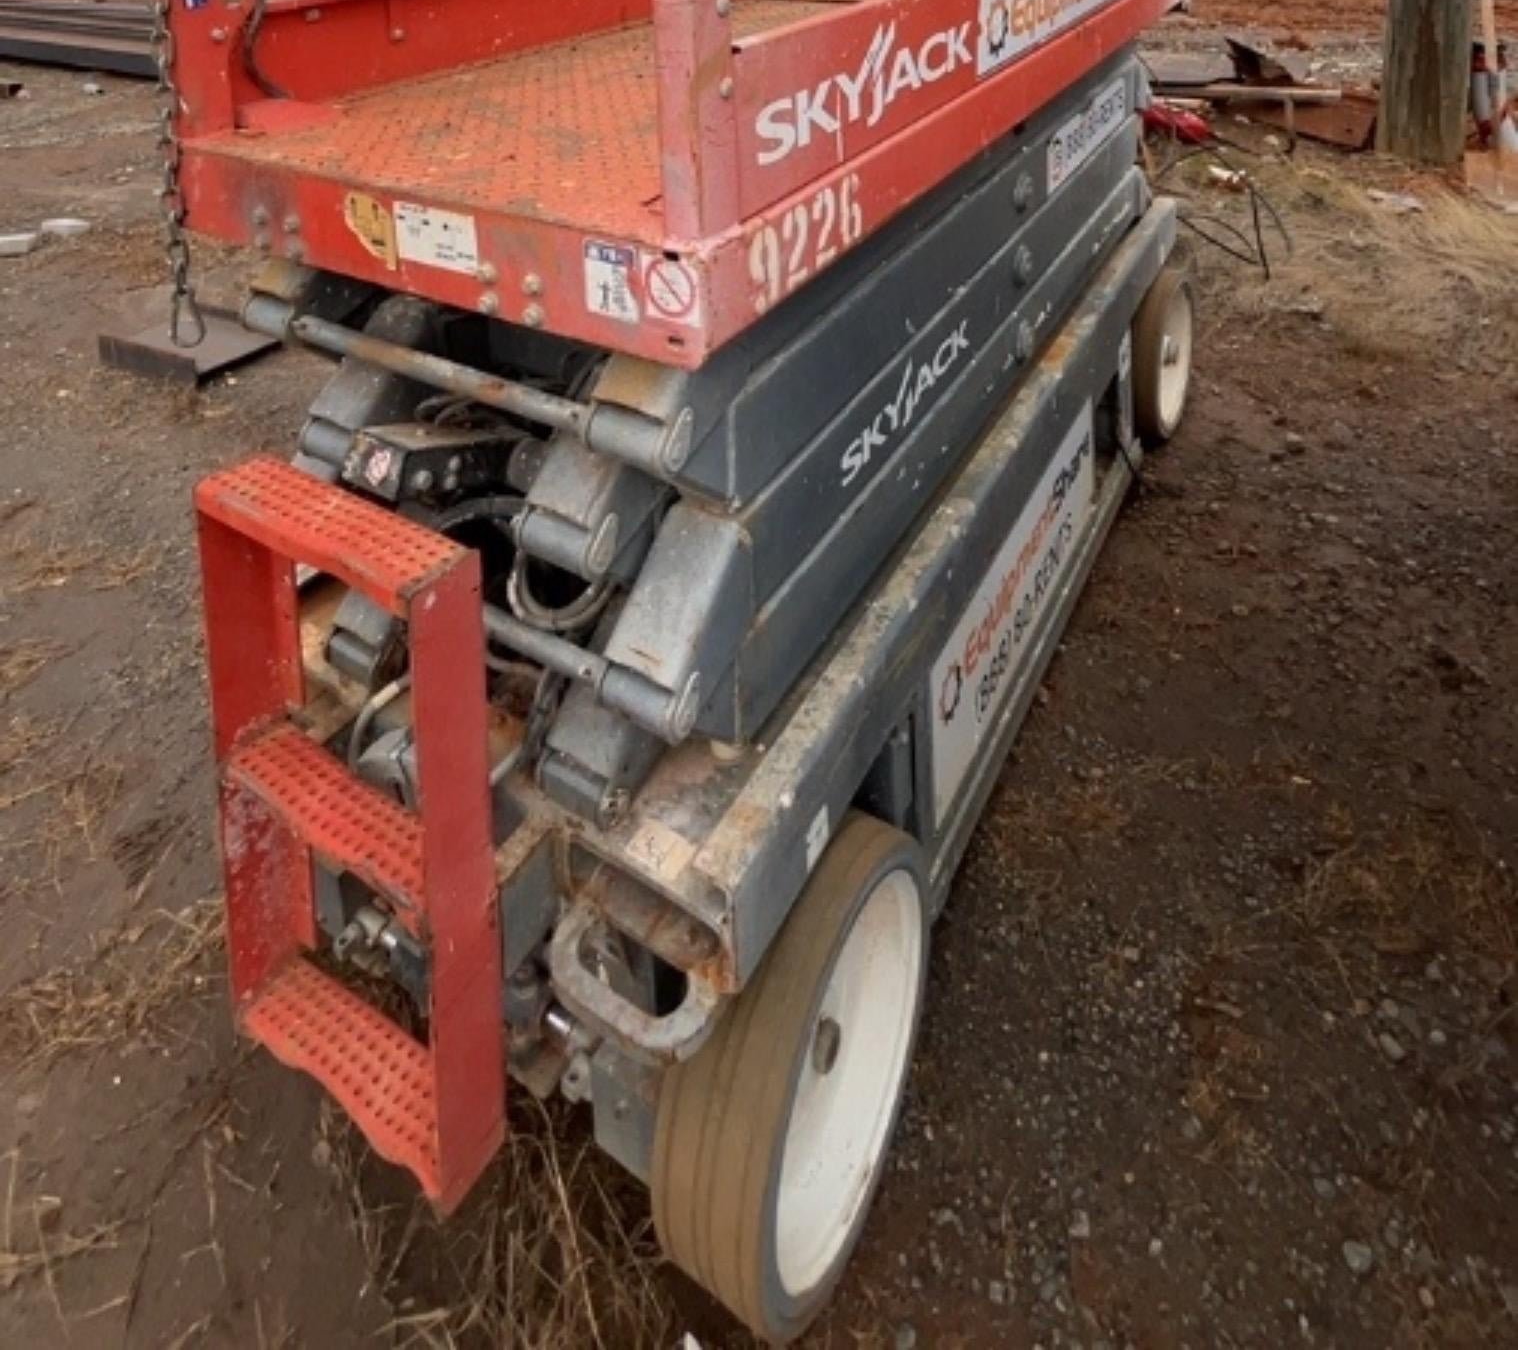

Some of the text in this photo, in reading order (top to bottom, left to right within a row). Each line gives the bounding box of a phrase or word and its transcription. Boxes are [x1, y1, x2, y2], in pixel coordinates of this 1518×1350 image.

[755, 18, 973, 166] SKYJACK
[749, 172, 862, 316] 9226
[840, 317, 970, 488] SKYJACK
